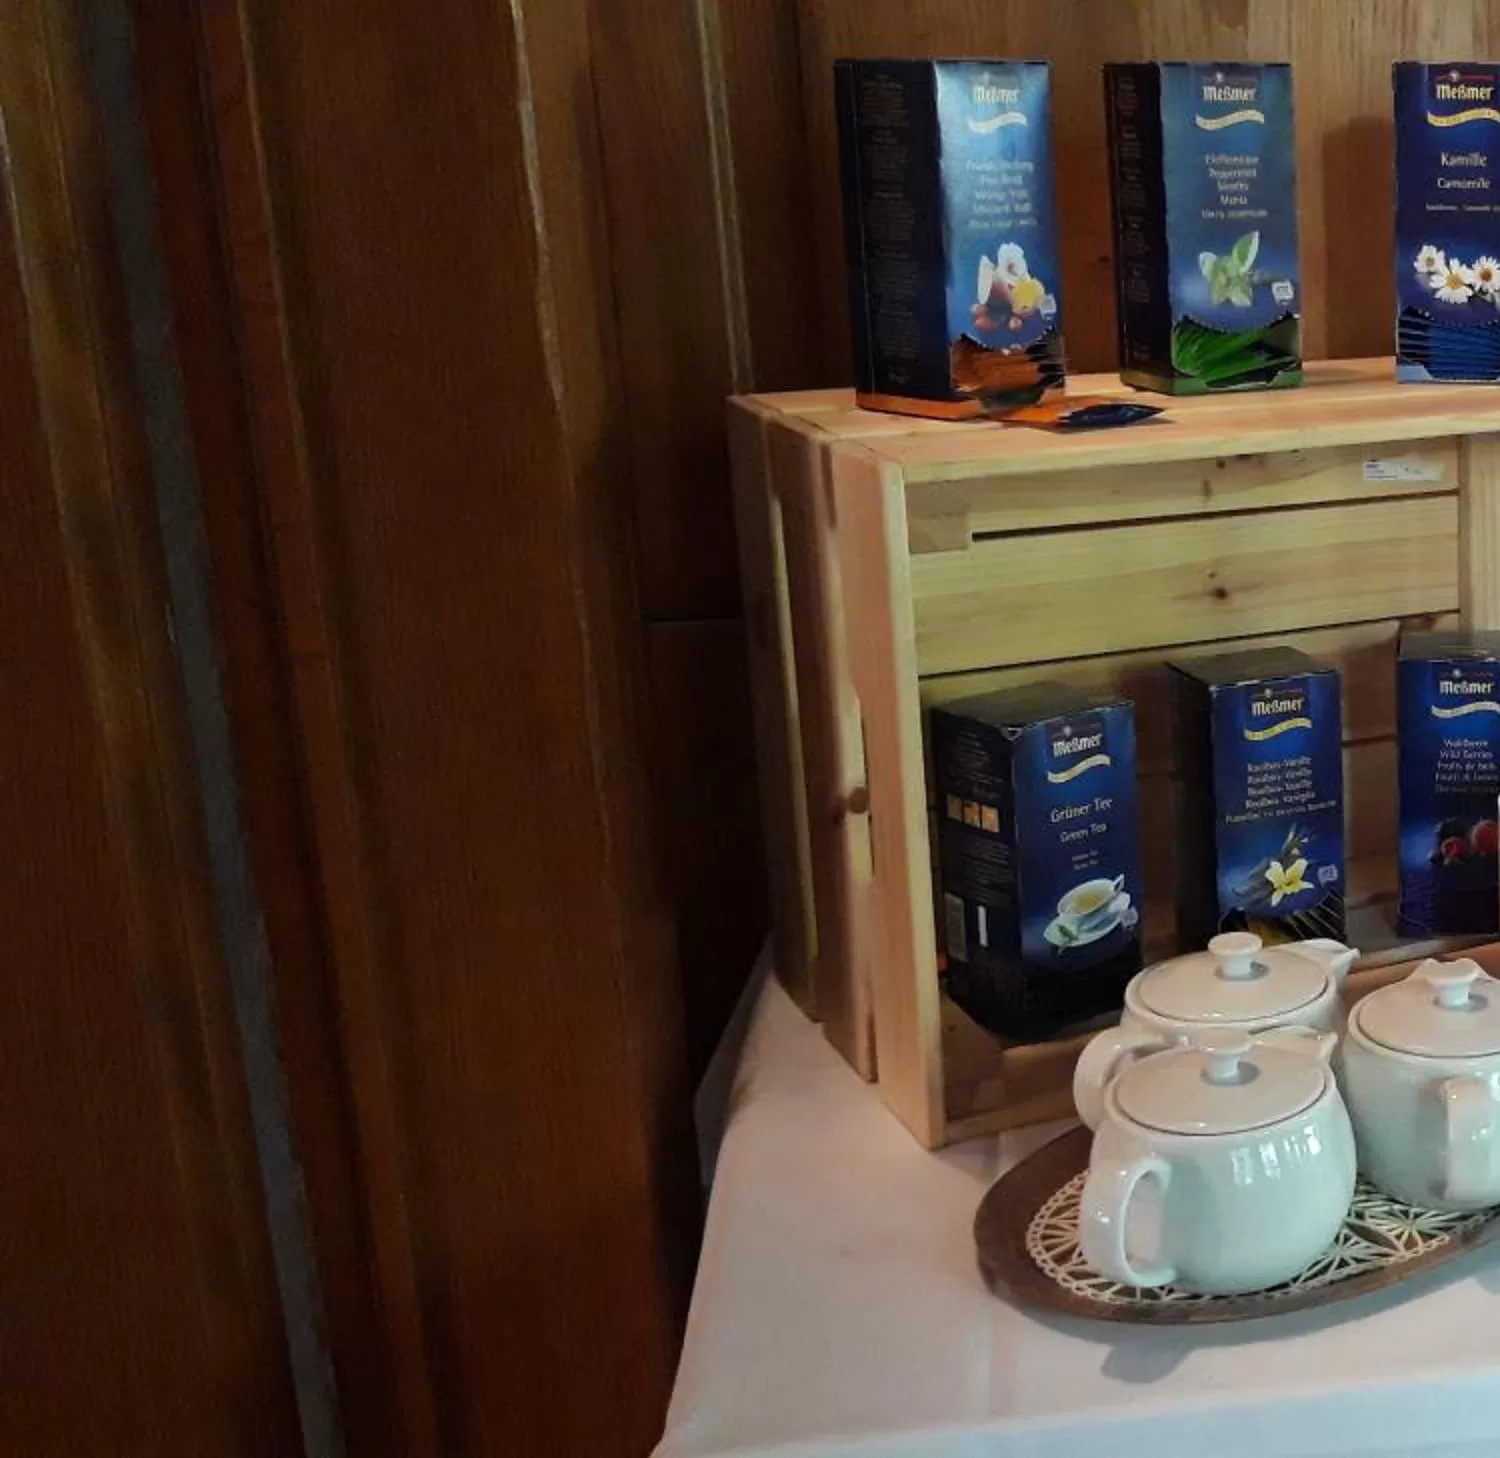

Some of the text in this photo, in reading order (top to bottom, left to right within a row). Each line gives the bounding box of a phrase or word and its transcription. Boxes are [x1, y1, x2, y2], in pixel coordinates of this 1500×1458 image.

[1435, 83, 1495, 101] Meßmer
[1439, 679, 1497, 696] Meßmer
[1251, 697, 1305, 717] Meßmer
[1052, 733, 1104, 758] Meßmer
